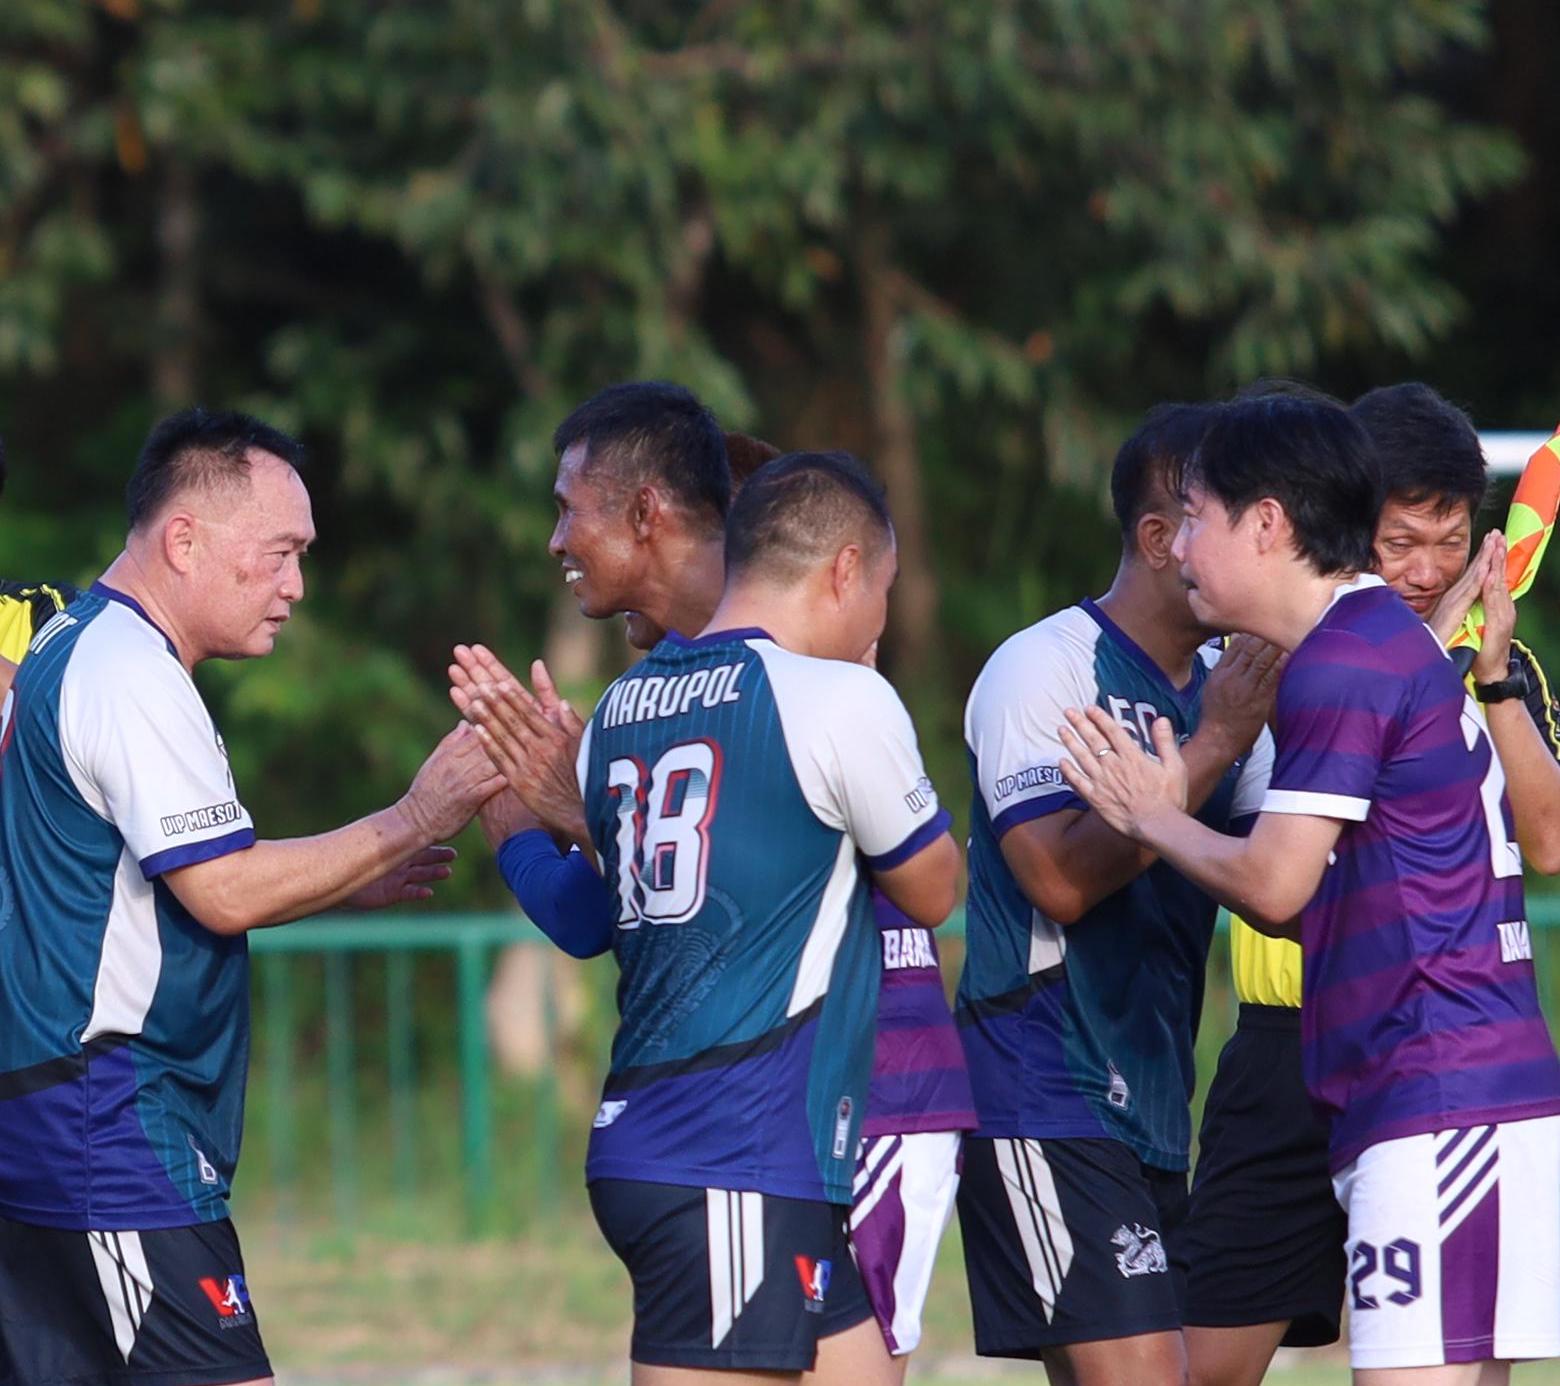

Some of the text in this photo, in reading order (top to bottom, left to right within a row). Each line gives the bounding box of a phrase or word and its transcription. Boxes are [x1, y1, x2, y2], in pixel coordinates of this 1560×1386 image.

[602, 662, 745, 730] NARUPOL
[1016, 766, 1069, 791] MAESO
[184, 800, 242, 832] MAESOT
[607, 736, 724, 931] 18
[1350, 1236, 1422, 1310] 29
